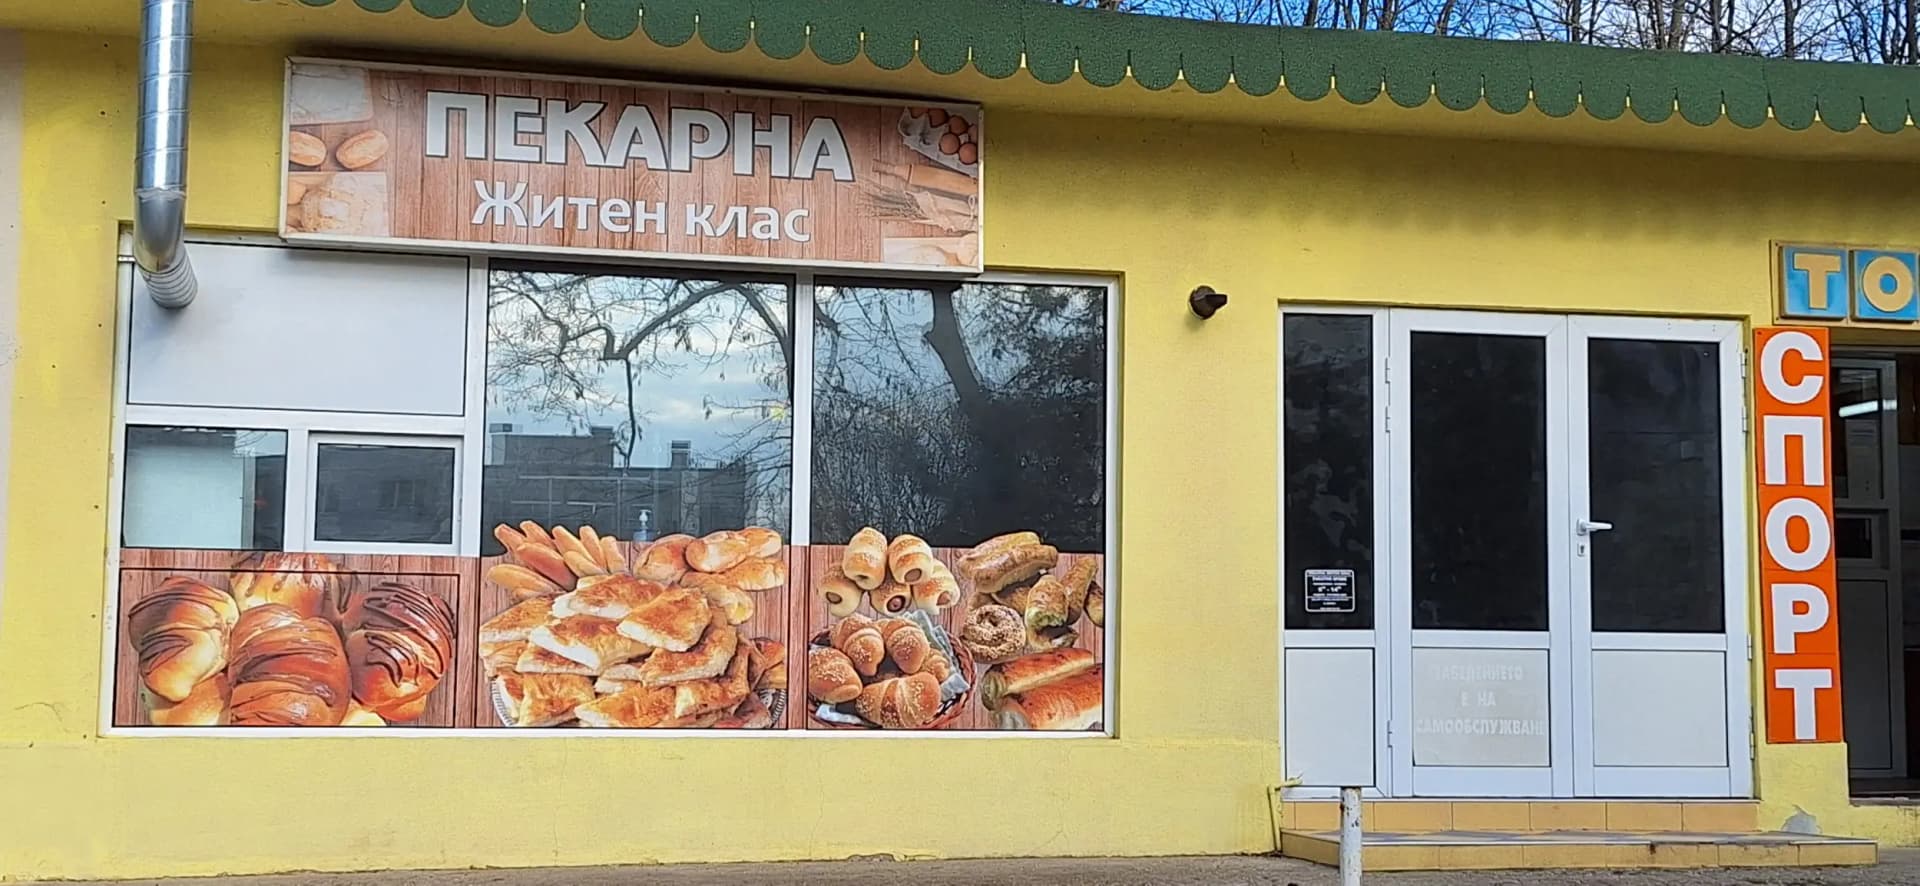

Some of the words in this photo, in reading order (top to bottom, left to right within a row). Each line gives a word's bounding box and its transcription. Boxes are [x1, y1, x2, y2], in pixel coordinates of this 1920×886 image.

[425, 89, 855, 182] ПЕКАРНА
[472, 179, 667, 233] Житен
[685, 203, 811, 242] клас
[1793, 253, 1914, 313] ТО
[1760, 331, 1833, 740] СПОРТ
[1477, 690, 1497, 706] НА
